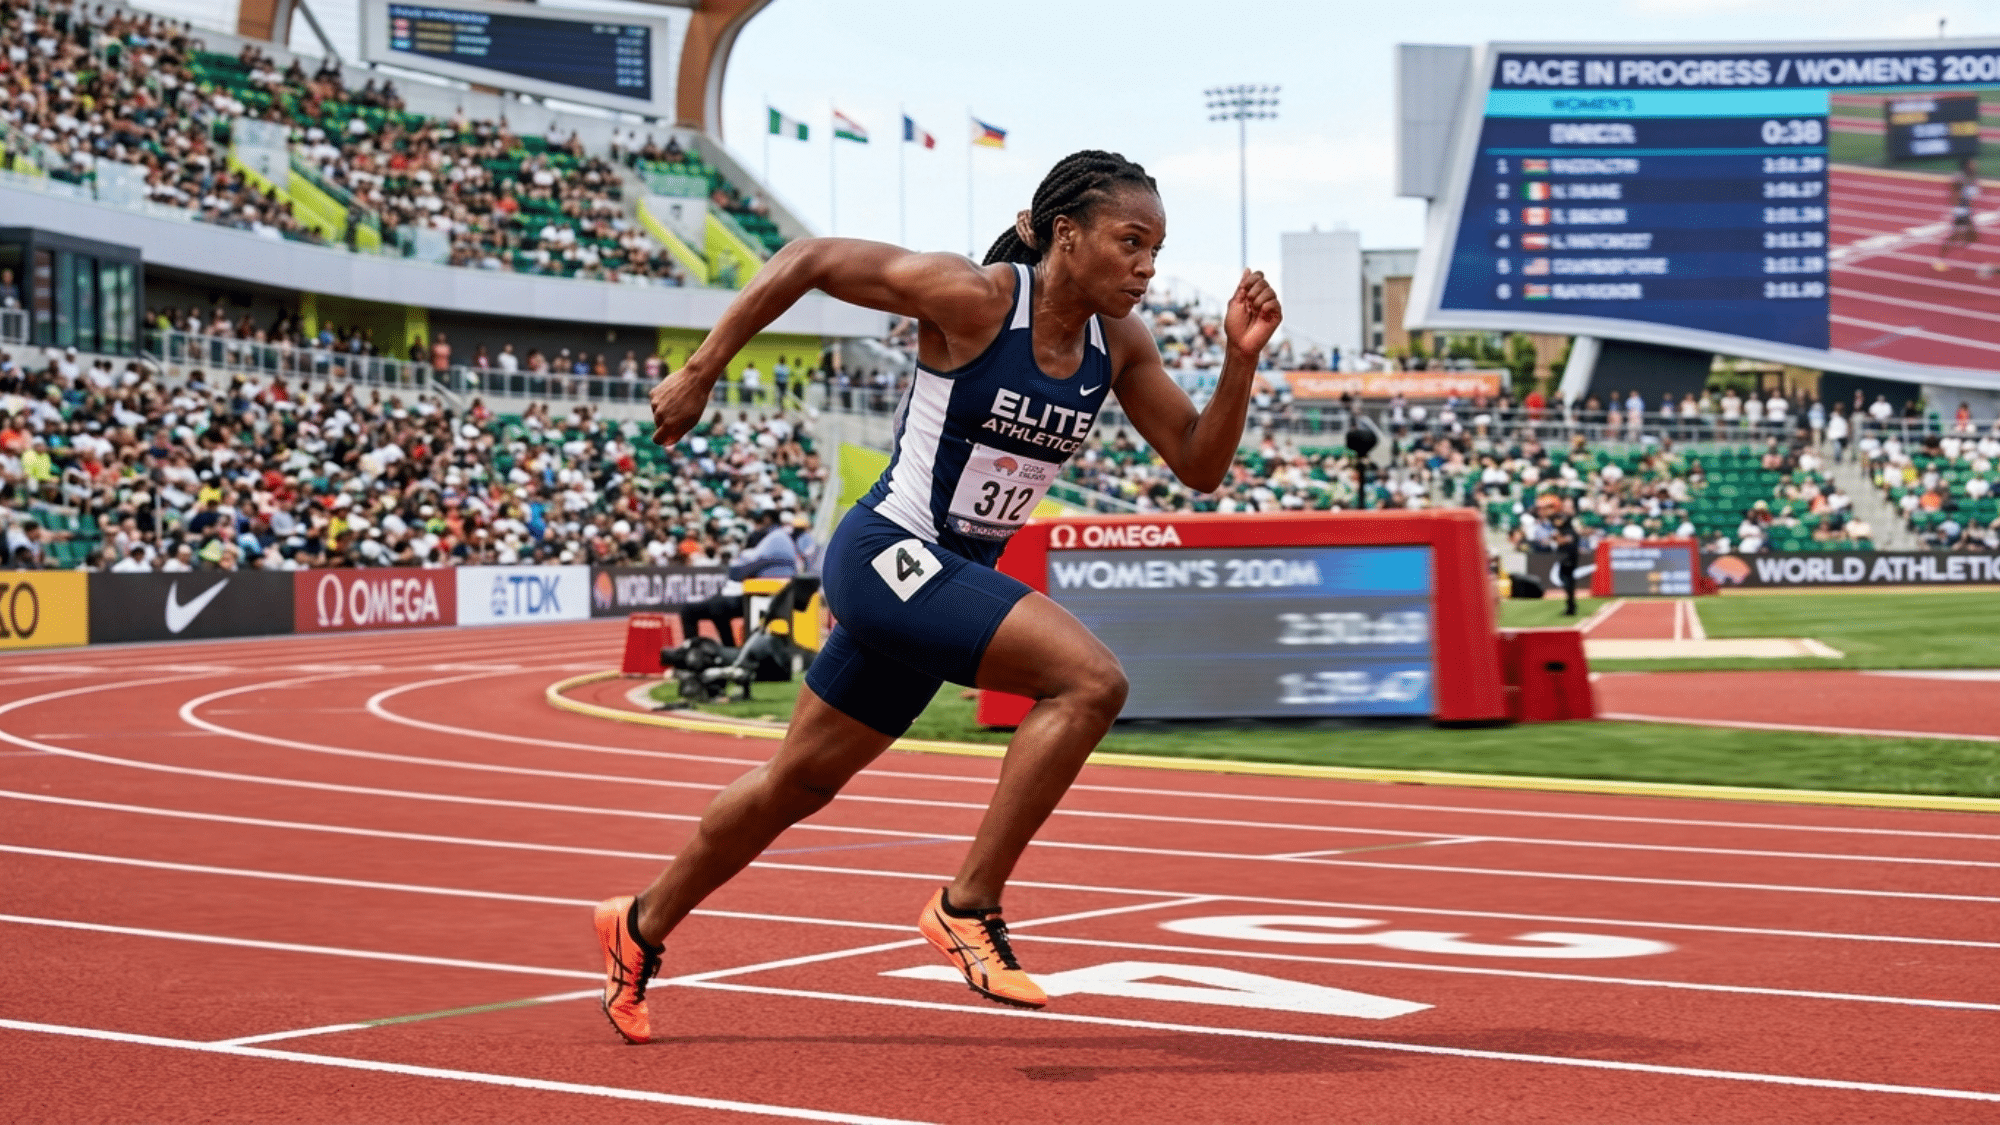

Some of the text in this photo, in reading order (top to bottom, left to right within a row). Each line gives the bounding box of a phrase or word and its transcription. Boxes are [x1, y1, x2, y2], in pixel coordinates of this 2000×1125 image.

[1503, 59, 1579, 85] RACE
[1585, 60, 1614, 84] IN
[1620, 58, 1771, 84] PROGRESS
[1796, 56, 1936, 83] WOMEN'S
[1941, 55, 2000, 82] 200
[991, 388, 1093, 439] ELITE
[974, 481, 1034, 521] 312
[1082, 525, 1182, 547] OMEGA
[896, 547, 924, 581] 4
[1052, 559, 1322, 589] WOMEN'S 200M
[1756, 557, 1866, 583] WORLD
[349, 577, 440, 625] OMEGA
[509, 575, 562, 615] TDK
